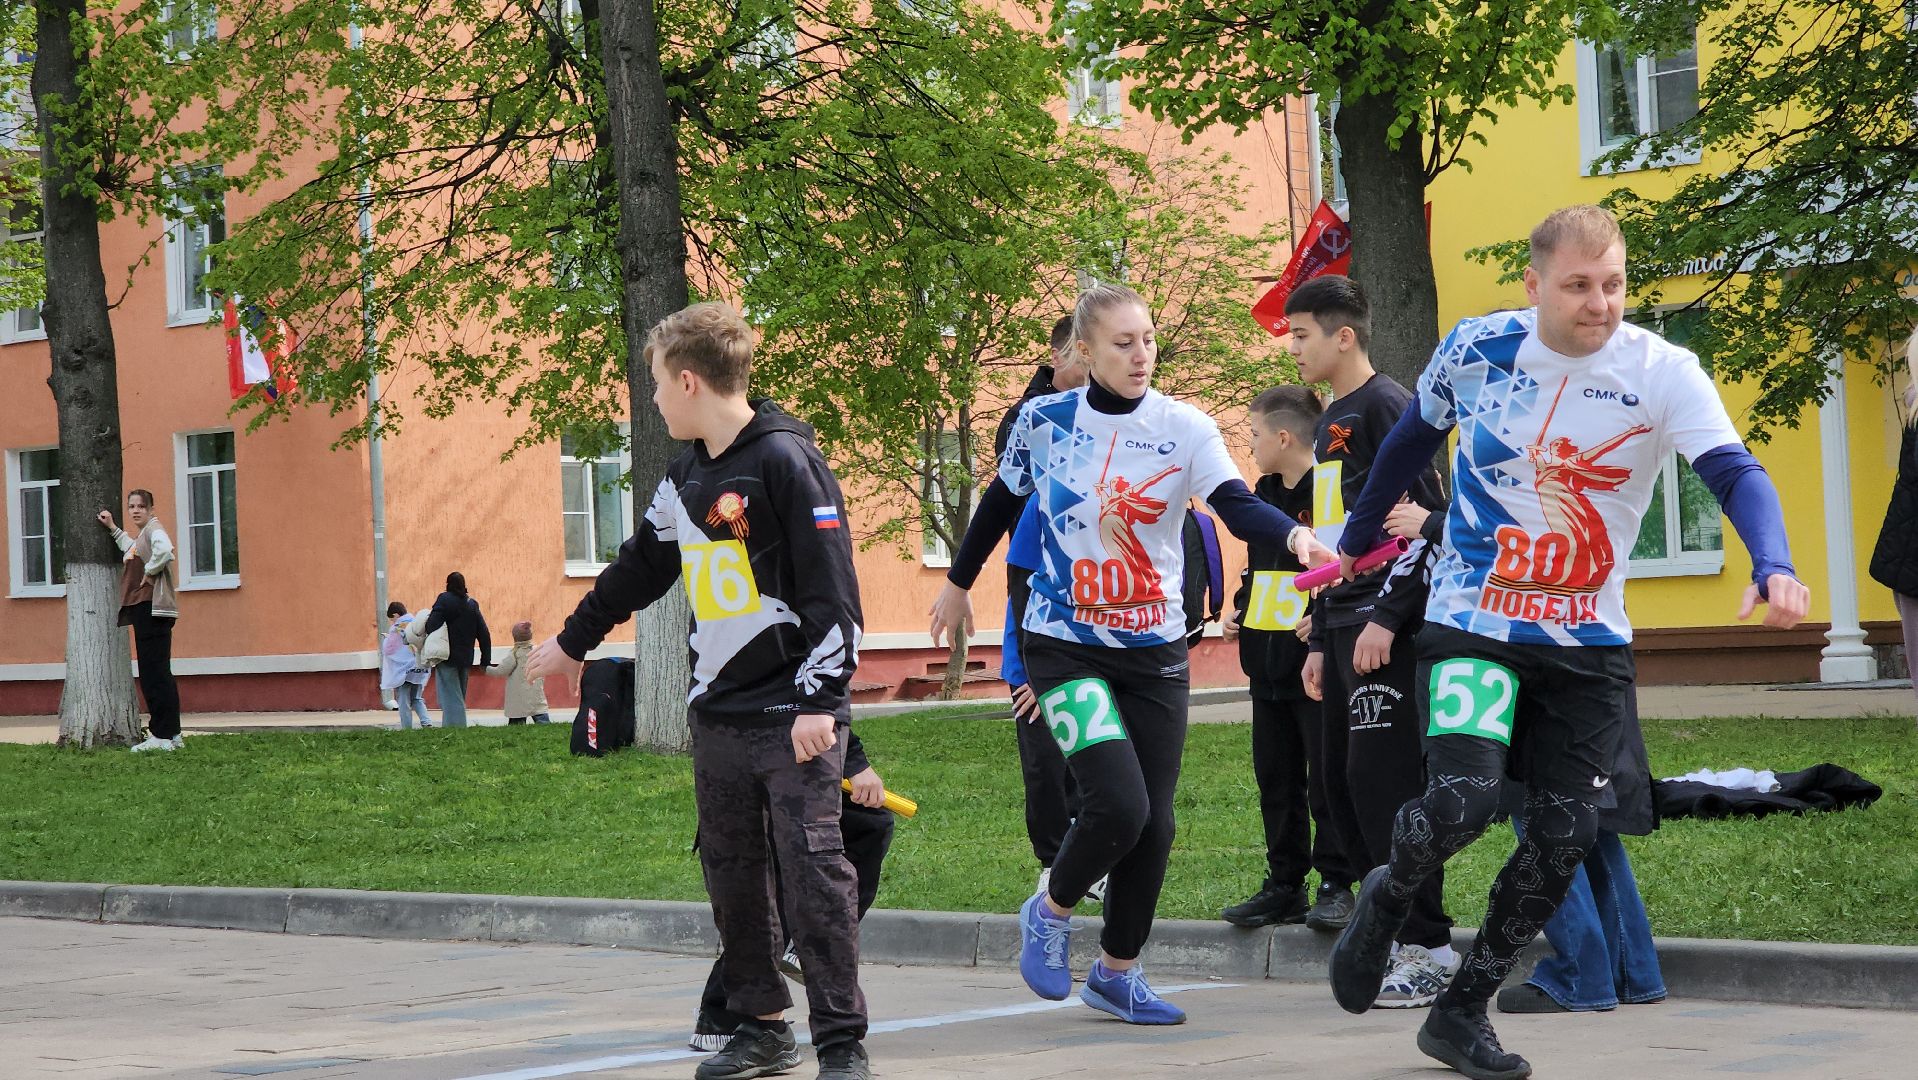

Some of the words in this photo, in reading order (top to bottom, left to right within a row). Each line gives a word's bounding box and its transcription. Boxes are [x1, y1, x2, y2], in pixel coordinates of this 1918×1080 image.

[1583, 388, 1619, 401] СМК
[1125, 440, 1156, 451] СМК
[682, 547, 750, 613] 76
[1073, 558, 1129, 605] 80
[1496, 527, 1571, 586] 80
[1255, 575, 1304, 627] 75
[1044, 682, 1122, 752] 52
[1435, 663, 1513, 740] 52
